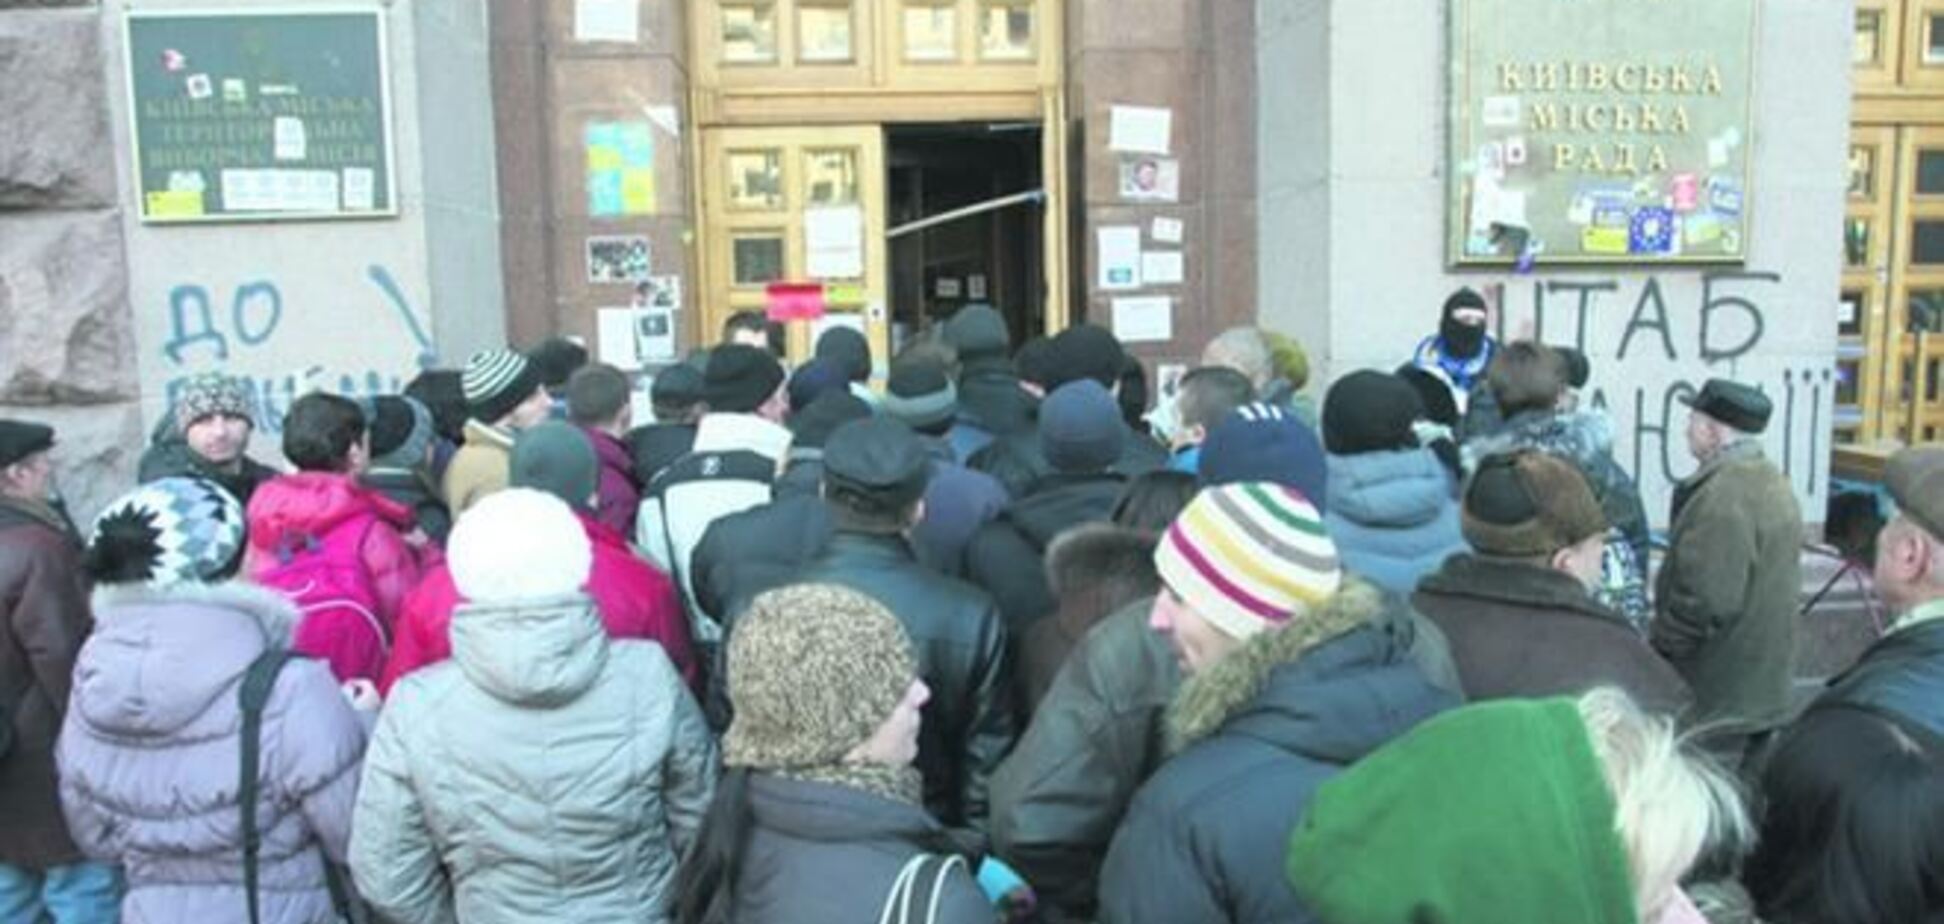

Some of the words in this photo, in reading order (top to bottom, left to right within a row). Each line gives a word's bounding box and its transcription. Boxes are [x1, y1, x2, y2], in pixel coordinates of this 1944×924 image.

[1529, 101, 1689, 134] МІСЬКА
[1552, 142, 1668, 177] РАДА
[163, 284, 281, 365] ДО
